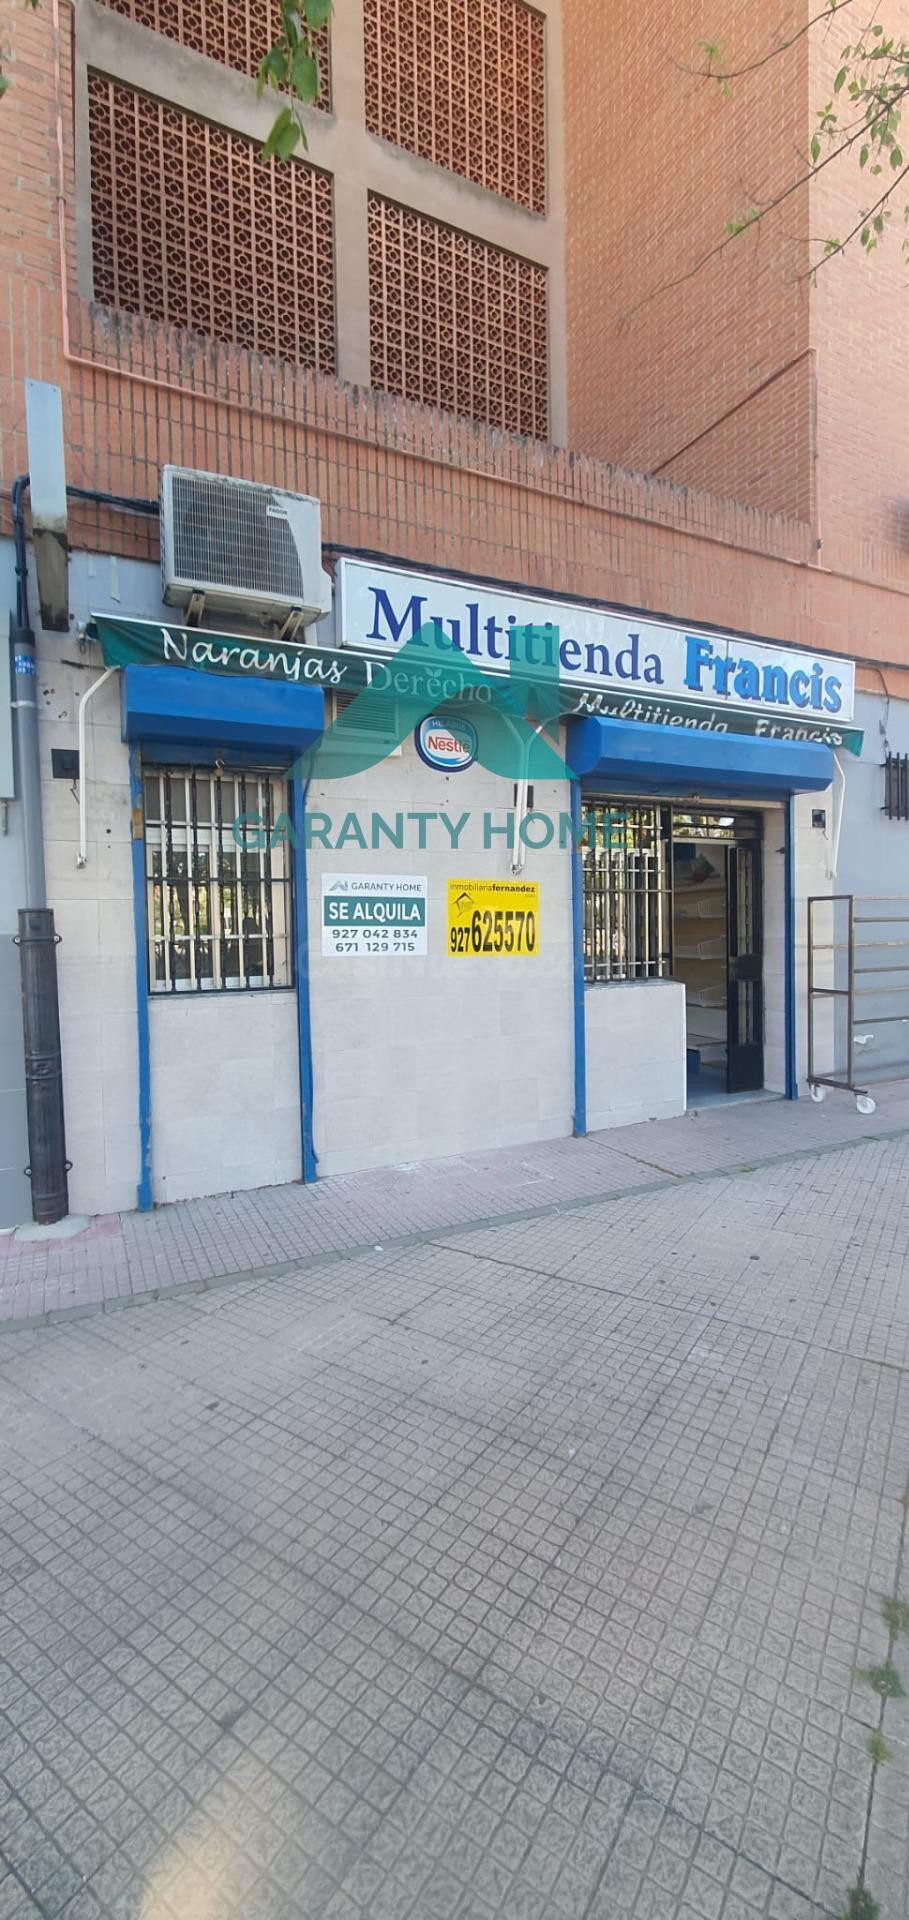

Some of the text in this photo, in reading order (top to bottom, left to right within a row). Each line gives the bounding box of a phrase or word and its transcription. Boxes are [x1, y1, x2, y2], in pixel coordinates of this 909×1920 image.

[367, 586, 842, 713] Multitienda Francis
[161, 628, 491, 703] Naranjas Derecho
[351, 881, 422, 892] GARANTY HOME
[329, 902, 420, 922] SE ALQUILA
[332, 929, 418, 939] 927 042 834
[336, 943, 415, 952] 671 129 715
